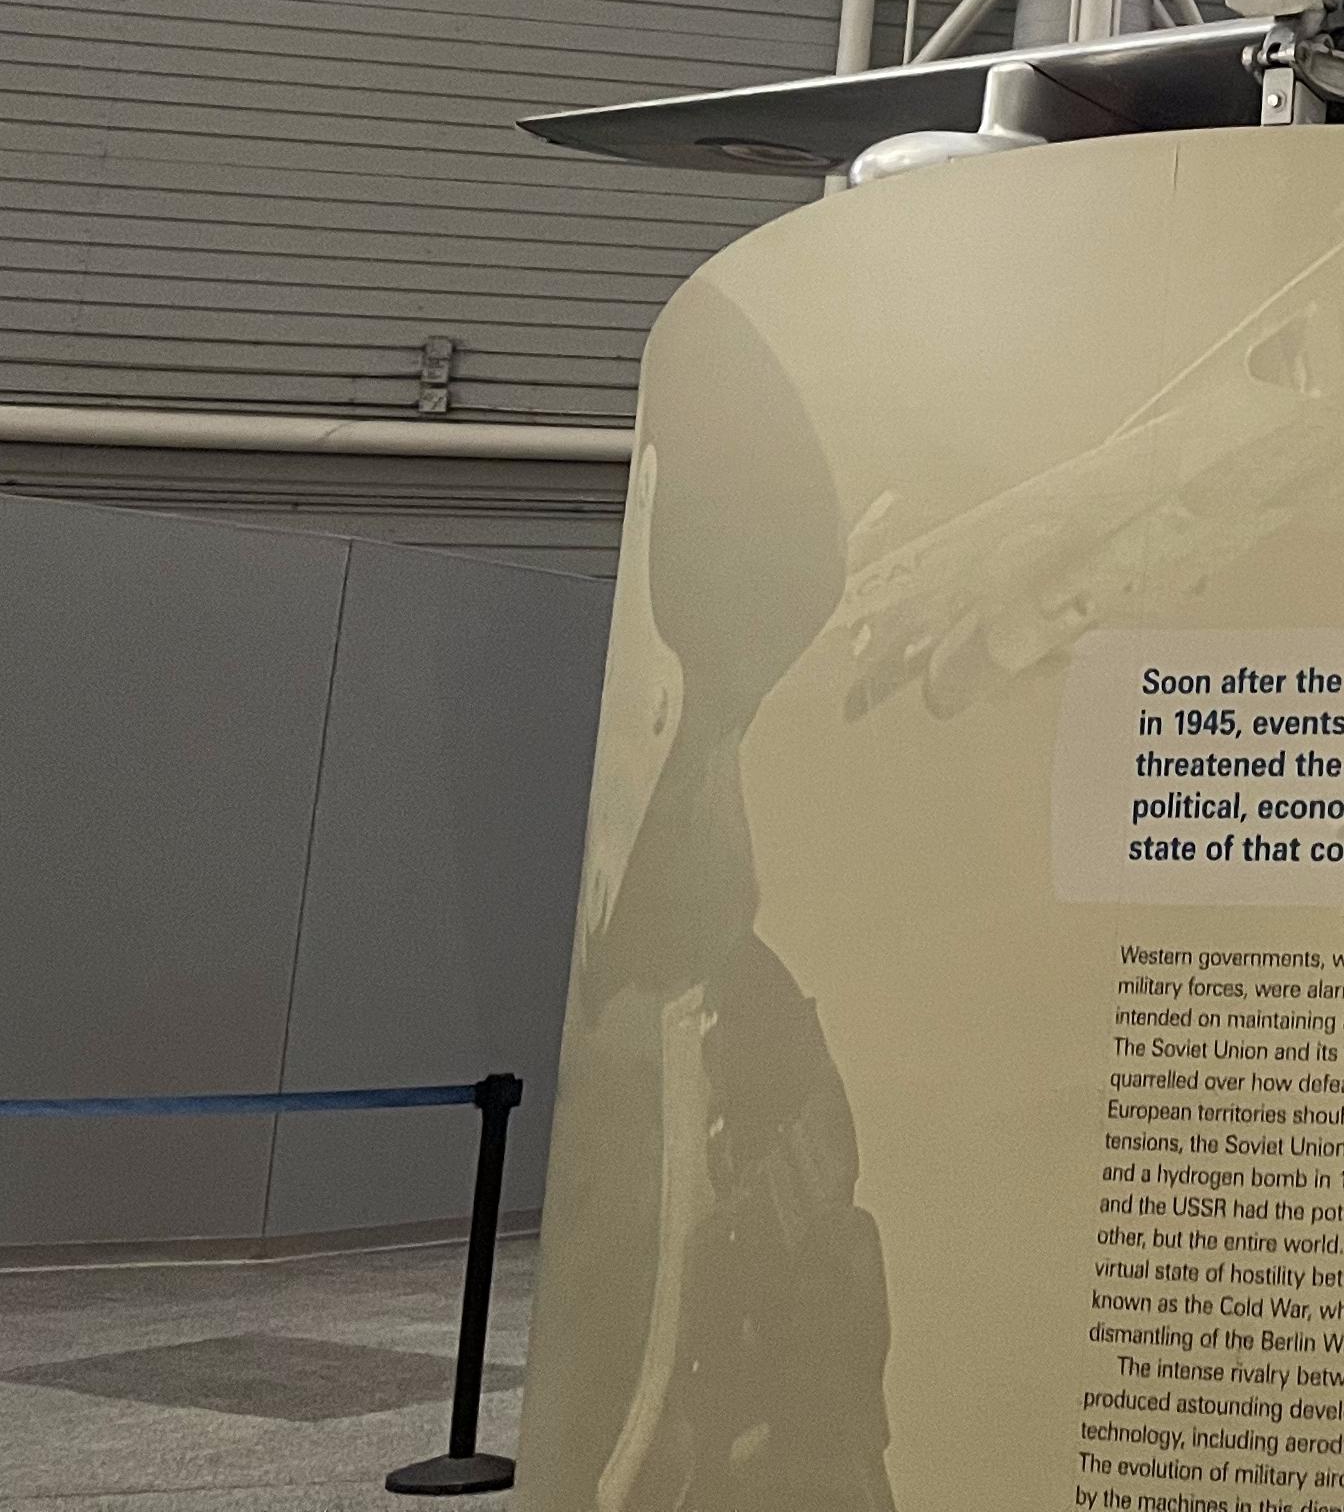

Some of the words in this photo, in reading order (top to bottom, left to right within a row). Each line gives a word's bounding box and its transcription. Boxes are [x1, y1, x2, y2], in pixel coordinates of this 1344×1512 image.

[1140, 667, 1213, 695] Soon
[1219, 666, 1289, 694] after
[1294, 666, 1344, 694] the
[1138, 708, 1164, 736] in
[1172, 709, 1244, 740] 1945,
[1134, 749, 1287, 778] threatened
[1293, 749, 1344, 778] the
[1131, 791, 1250, 826] political,
[1127, 835, 1198, 862] state
[1204, 833, 1236, 862] of
[1240, 833, 1303, 862] that
[1119, 945, 1193, 967] Western
[1197, 950, 1327, 971] governments,
[1113, 1038, 1147, 1058] The
[1150, 1039, 1210, 1060] Soviet
[1213, 1040, 1270, 1061] Union
[1273, 1043, 1311, 1063] and
[1314, 1043, 1339, 1063] its
[1106, 1100, 1193, 1125] European
[1197, 1103, 1288, 1127] territories
[1117, 1357, 1152, 1379] The
[1156, 1359, 1225, 1383] intense
[1229, 1364, 1291, 1390] rivalry
[1082, 1391, 1172, 1413] produced
[1175, 1395, 1284, 1423] astounding
[1079, 1454, 1113, 1476] The
[1116, 1459, 1204, 1483] evolution
[1208, 1464, 1230, 1483] of
[1233, 1465, 1309, 1491] military
